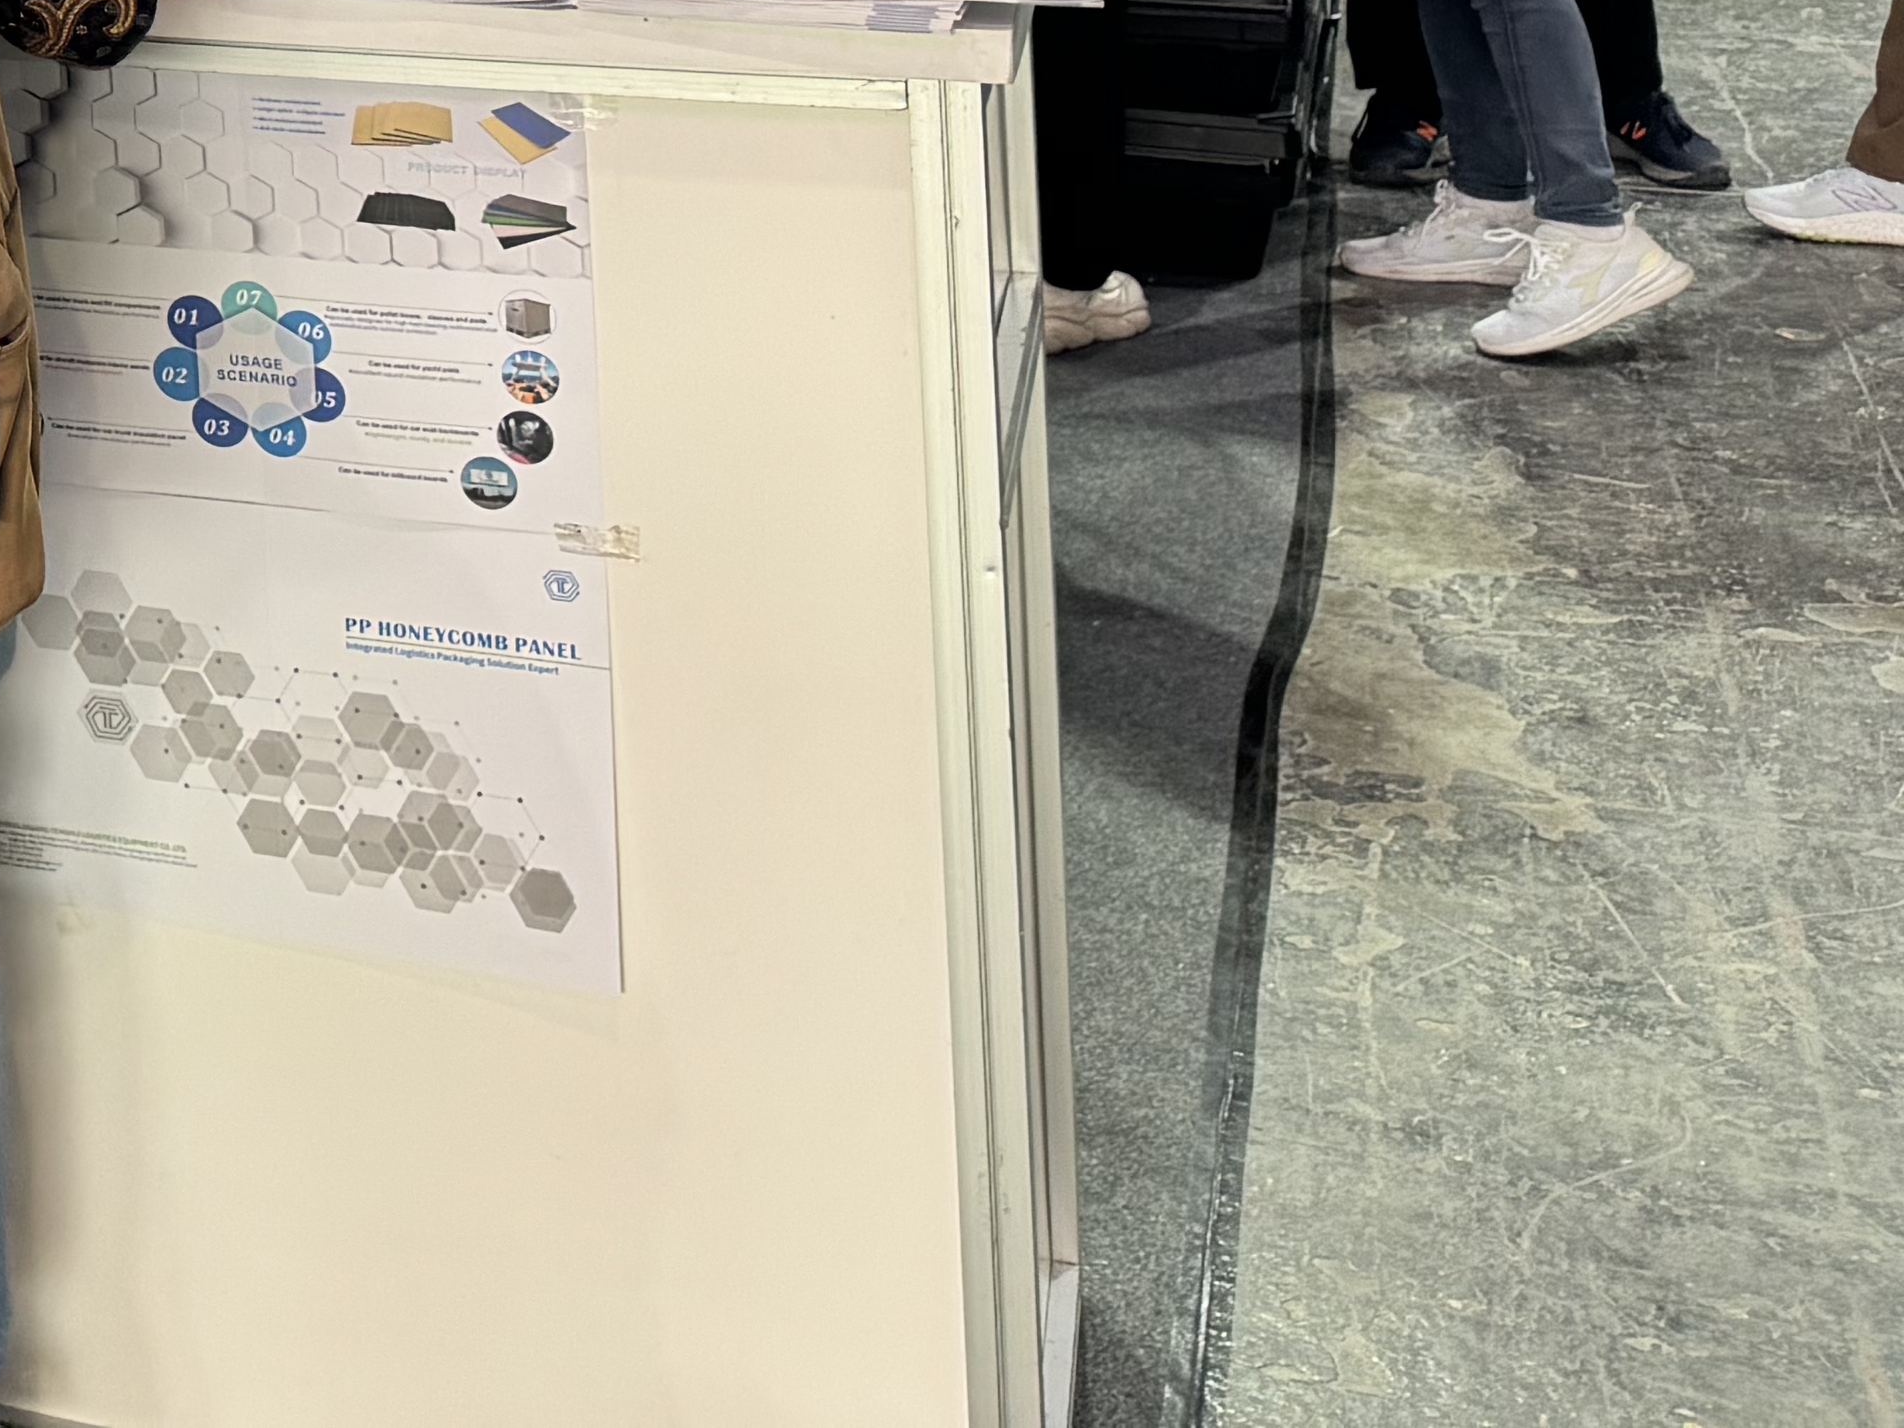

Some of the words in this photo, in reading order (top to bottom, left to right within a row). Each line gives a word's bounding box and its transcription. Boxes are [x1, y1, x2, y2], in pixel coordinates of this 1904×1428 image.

[236, 288, 262, 305] 07
[173, 308, 199, 326] 01
[298, 321, 325, 340] 06
[229, 353, 283, 370] USAGE
[161, 367, 189, 384] 02
[217, 368, 298, 388] SCENARIO
[203, 418, 230, 436] 03
[269, 427, 296, 446] 04
[345, 617, 372, 634] PP
[378, 621, 509, 651] HONEYCOMB
[515, 636, 582, 660] PANEL
[345, 642, 393, 656] Integrated
[395, 646, 435, 659] Logistics
[436, 651, 485, 667] Packaging
[486, 657, 526, 671] Solution
[528, 663, 559, 675] Expert
